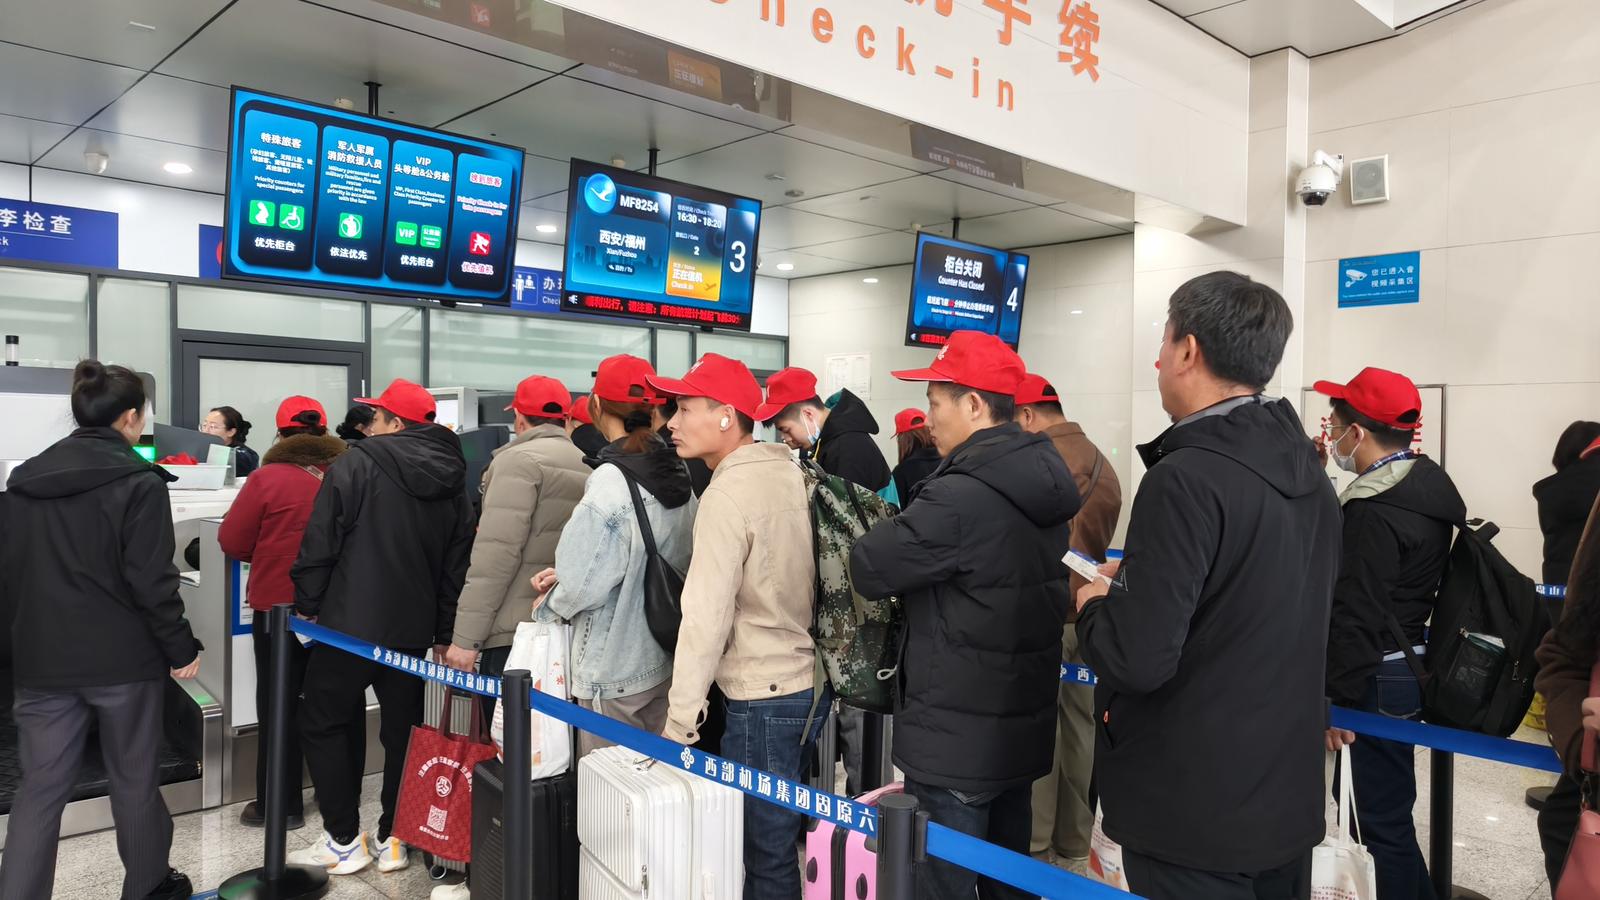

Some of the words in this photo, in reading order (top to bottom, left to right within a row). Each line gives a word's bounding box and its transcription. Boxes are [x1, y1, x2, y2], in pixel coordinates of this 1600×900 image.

[904, 0, 1100, 82] 手续
[709, 0, 1014, 111] eck-in
[261, 132, 302, 149] 特殊旅客
[338, 140, 374, 156] 军人军属
[328, 150, 382, 170] 消防救援人员
[416, 156, 432, 166] VIP
[254, 176, 274, 184] Priority
[394, 163, 450, 182] 头等舱&公务舱
[275, 186, 304, 194] passengers
[619, 194, 660, 214] MF8254
[0, 208, 72, 234] 李检查
[677, 212, 698, 224] 16:30
[702, 216, 722, 228] 18:20
[398, 228, 416, 238] VIP
[599, 229, 646, 250] 西安/福州
[254, 236, 296, 252] 优先柜台
[694, 246, 700, 256] 2
[330, 246, 368, 260] 依法优先
[400, 254, 434, 268] 优先柜台
[730, 240, 746, 273] 3
[944, 256, 983, 278] 柜台关闭
[938, 276, 958, 287] Counter
[958, 280, 968, 288] Has
[968, 280, 985, 291] Closed
[1006, 287, 1018, 312] 4
[705, 756, 875, 832] 西部机场集团固原六
